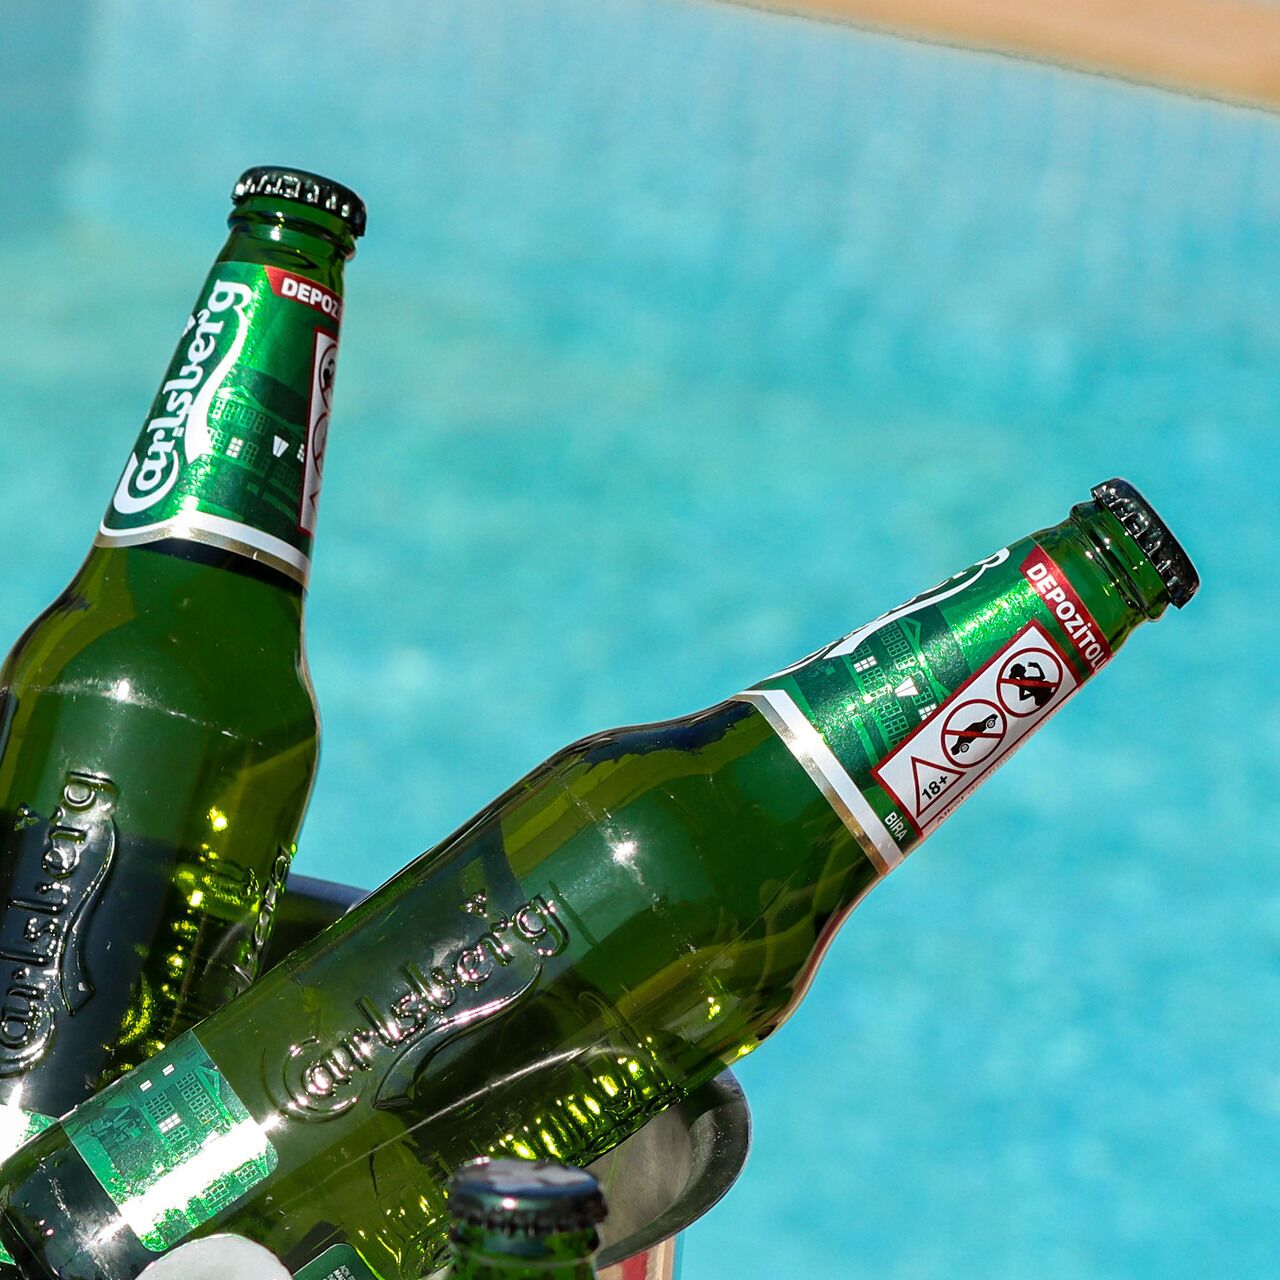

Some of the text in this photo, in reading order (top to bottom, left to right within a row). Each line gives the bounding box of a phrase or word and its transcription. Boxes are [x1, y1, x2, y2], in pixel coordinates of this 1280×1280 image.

[113, 278, 254, 514] Carlsberg
[921, 775, 948, 801] 18+
[884, 811, 909, 842] BİRA
